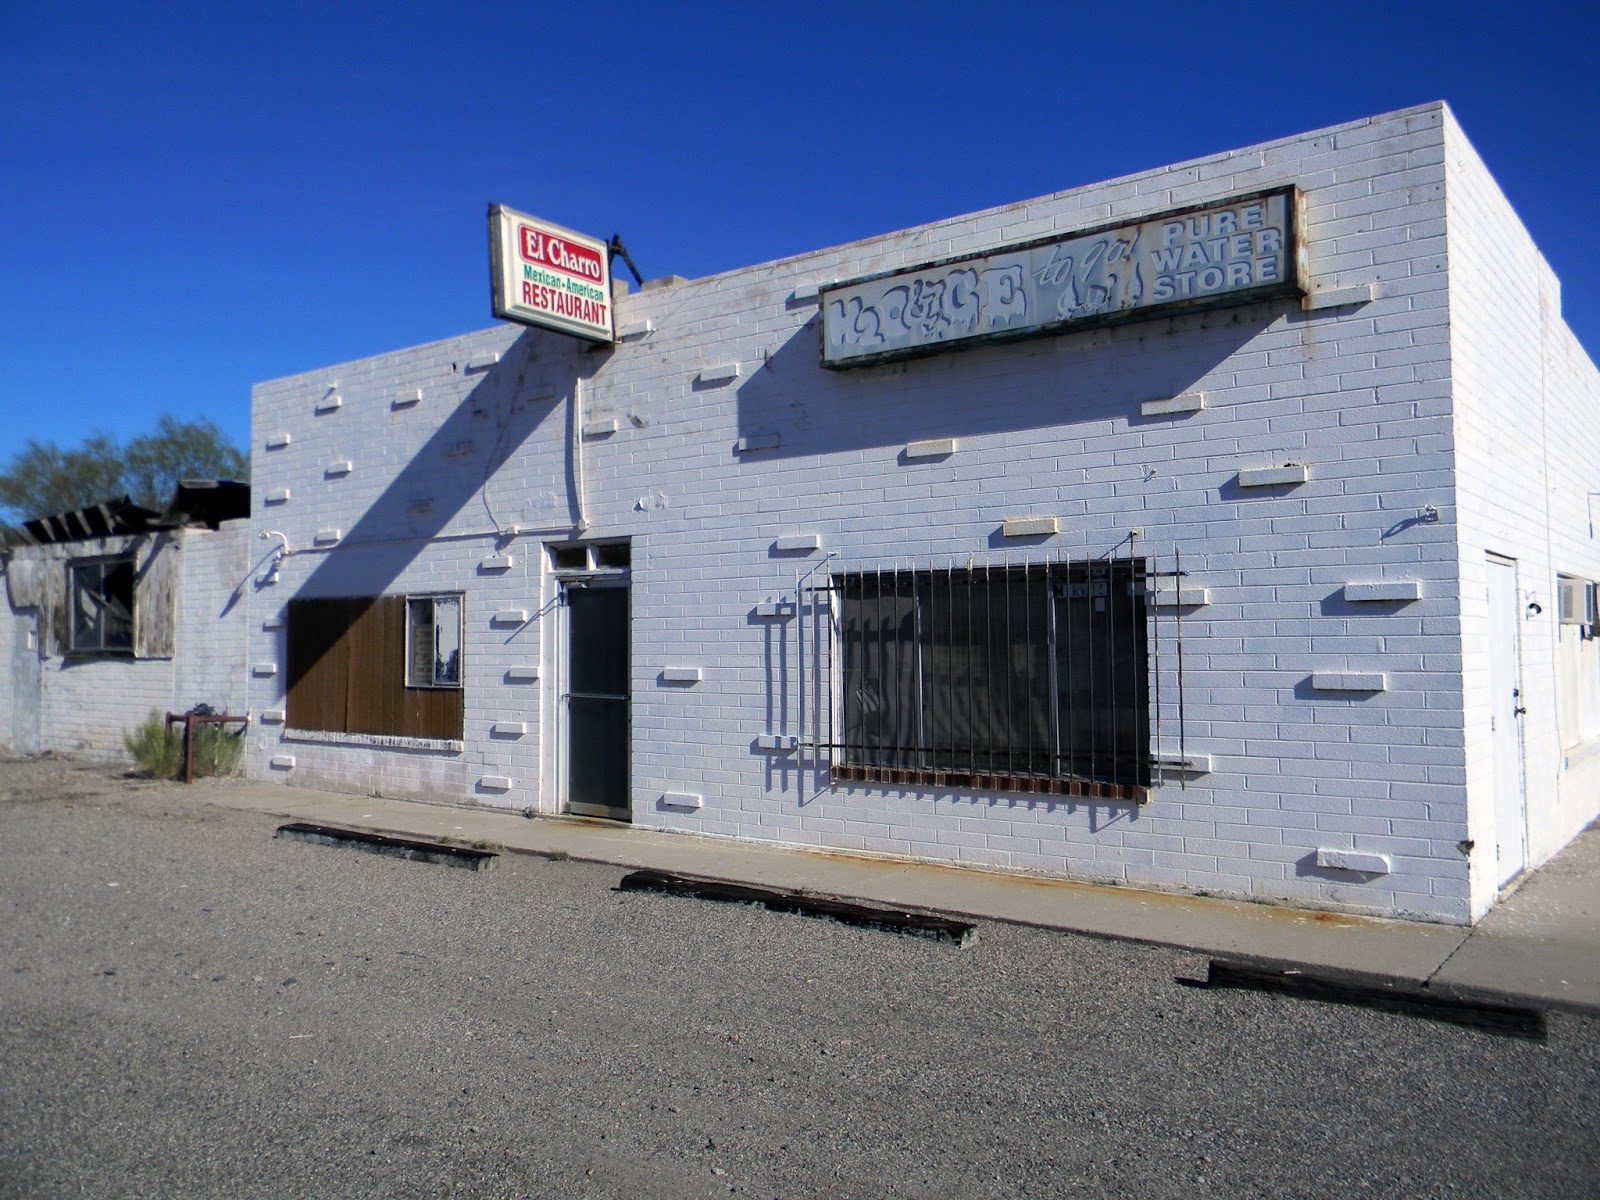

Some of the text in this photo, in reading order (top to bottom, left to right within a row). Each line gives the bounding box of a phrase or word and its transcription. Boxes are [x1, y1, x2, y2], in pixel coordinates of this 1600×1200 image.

[1163, 203, 1265, 247] PURE
[525, 230, 600, 278] El Charro
[1032, 244, 1074, 286] to
[1079, 226, 1142, 282] go!
[1151, 227, 1282, 273] WATER
[1152, 255, 1279, 300] STORE
[522, 281, 607, 326] RESTAURANT
